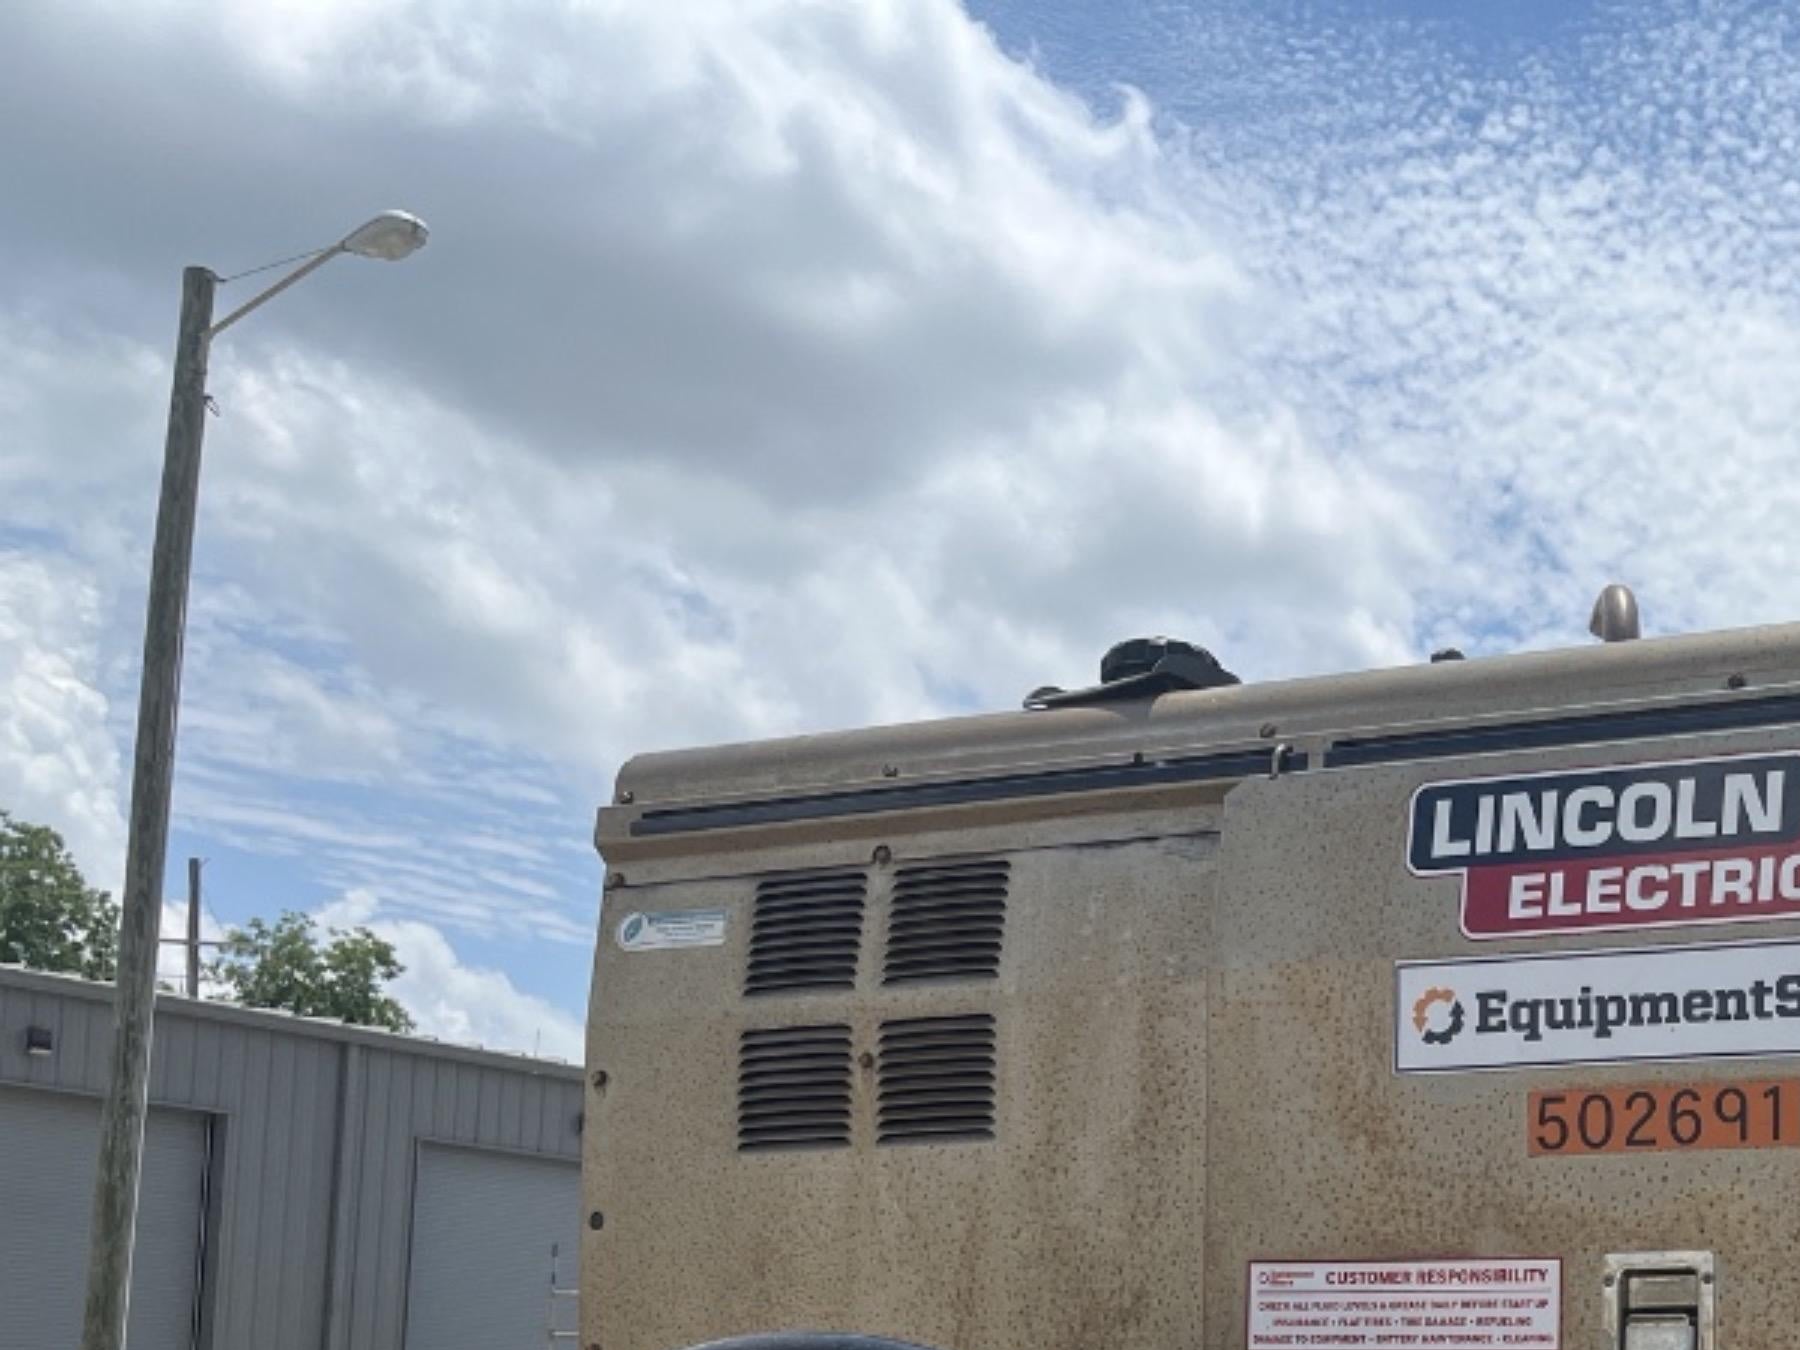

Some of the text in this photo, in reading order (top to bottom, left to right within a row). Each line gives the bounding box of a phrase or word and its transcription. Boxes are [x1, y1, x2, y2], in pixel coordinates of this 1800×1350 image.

[1430, 770, 1786, 858] LINCOLN
[1537, 1085, 1784, 1150] 502691
[1325, 1270, 1411, 1285] CUSTOMER
[1416, 1268, 1549, 1285] RESPONSIBILITY
